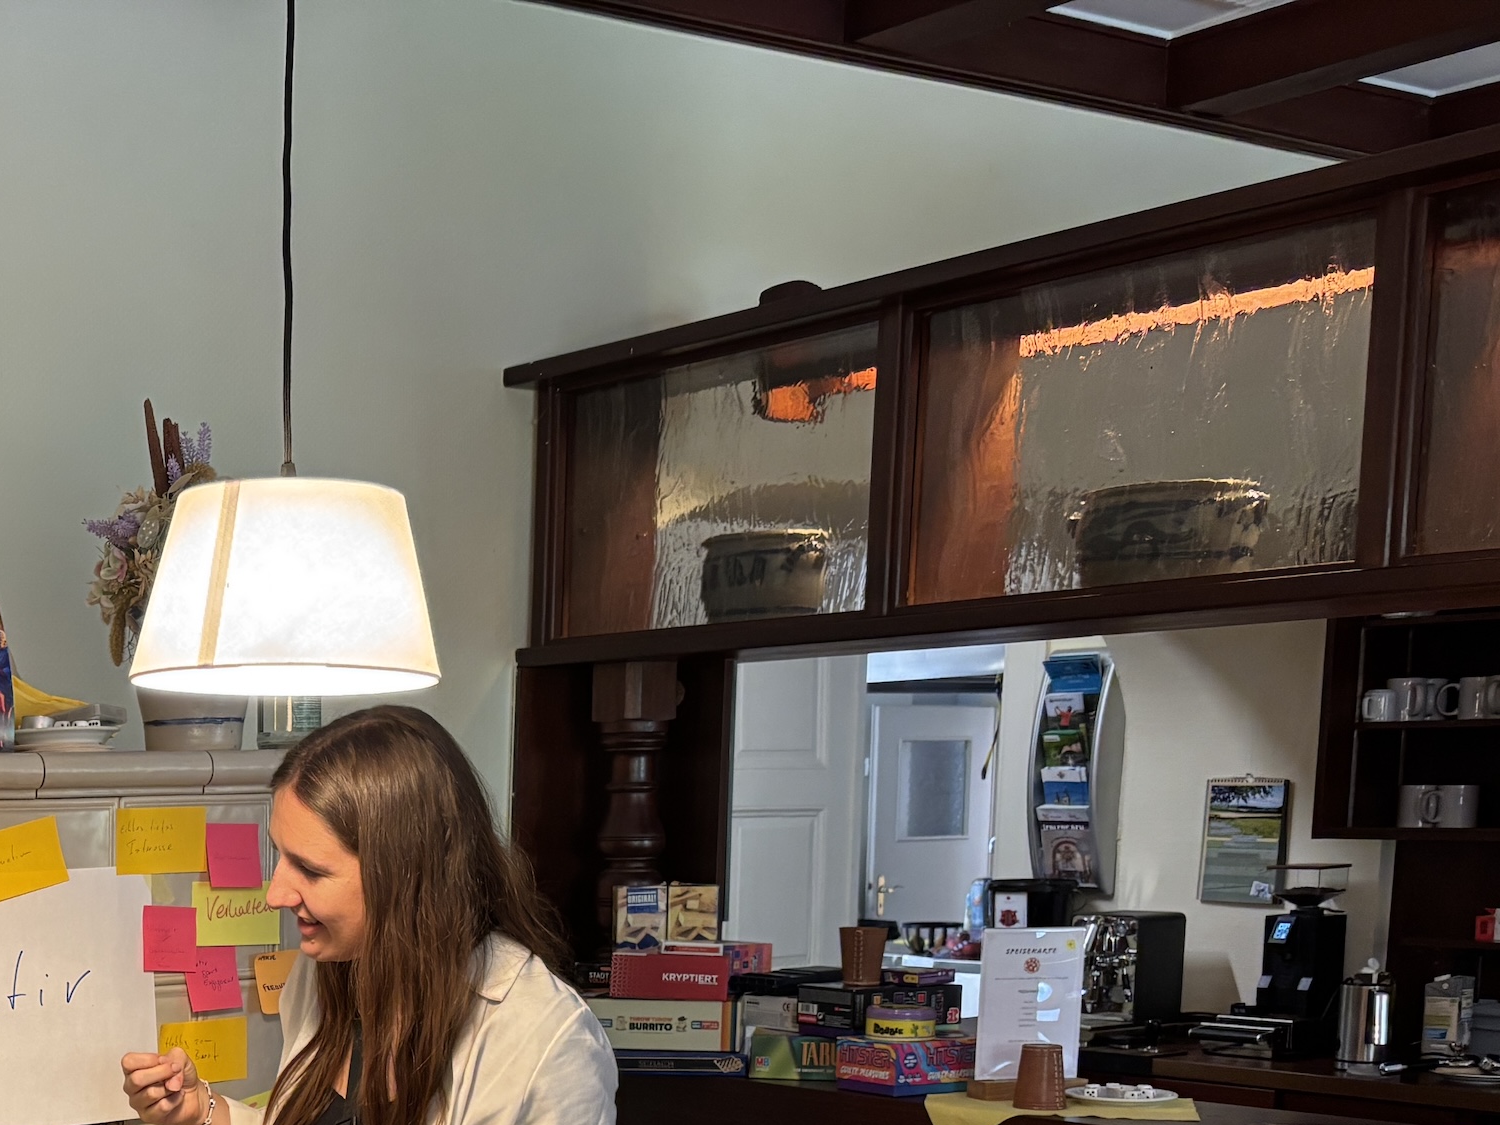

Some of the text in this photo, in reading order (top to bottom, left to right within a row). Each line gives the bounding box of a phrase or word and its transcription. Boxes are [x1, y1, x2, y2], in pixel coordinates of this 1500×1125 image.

[661, 972, 719, 985] KRYPTIERT
[628, 1022, 673, 1031] BURRITO
[755, 1057, 770, 1067] MB
[840, 1045, 891, 1068] HITSTER
[927, 1047, 975, 1066] HITSTE
